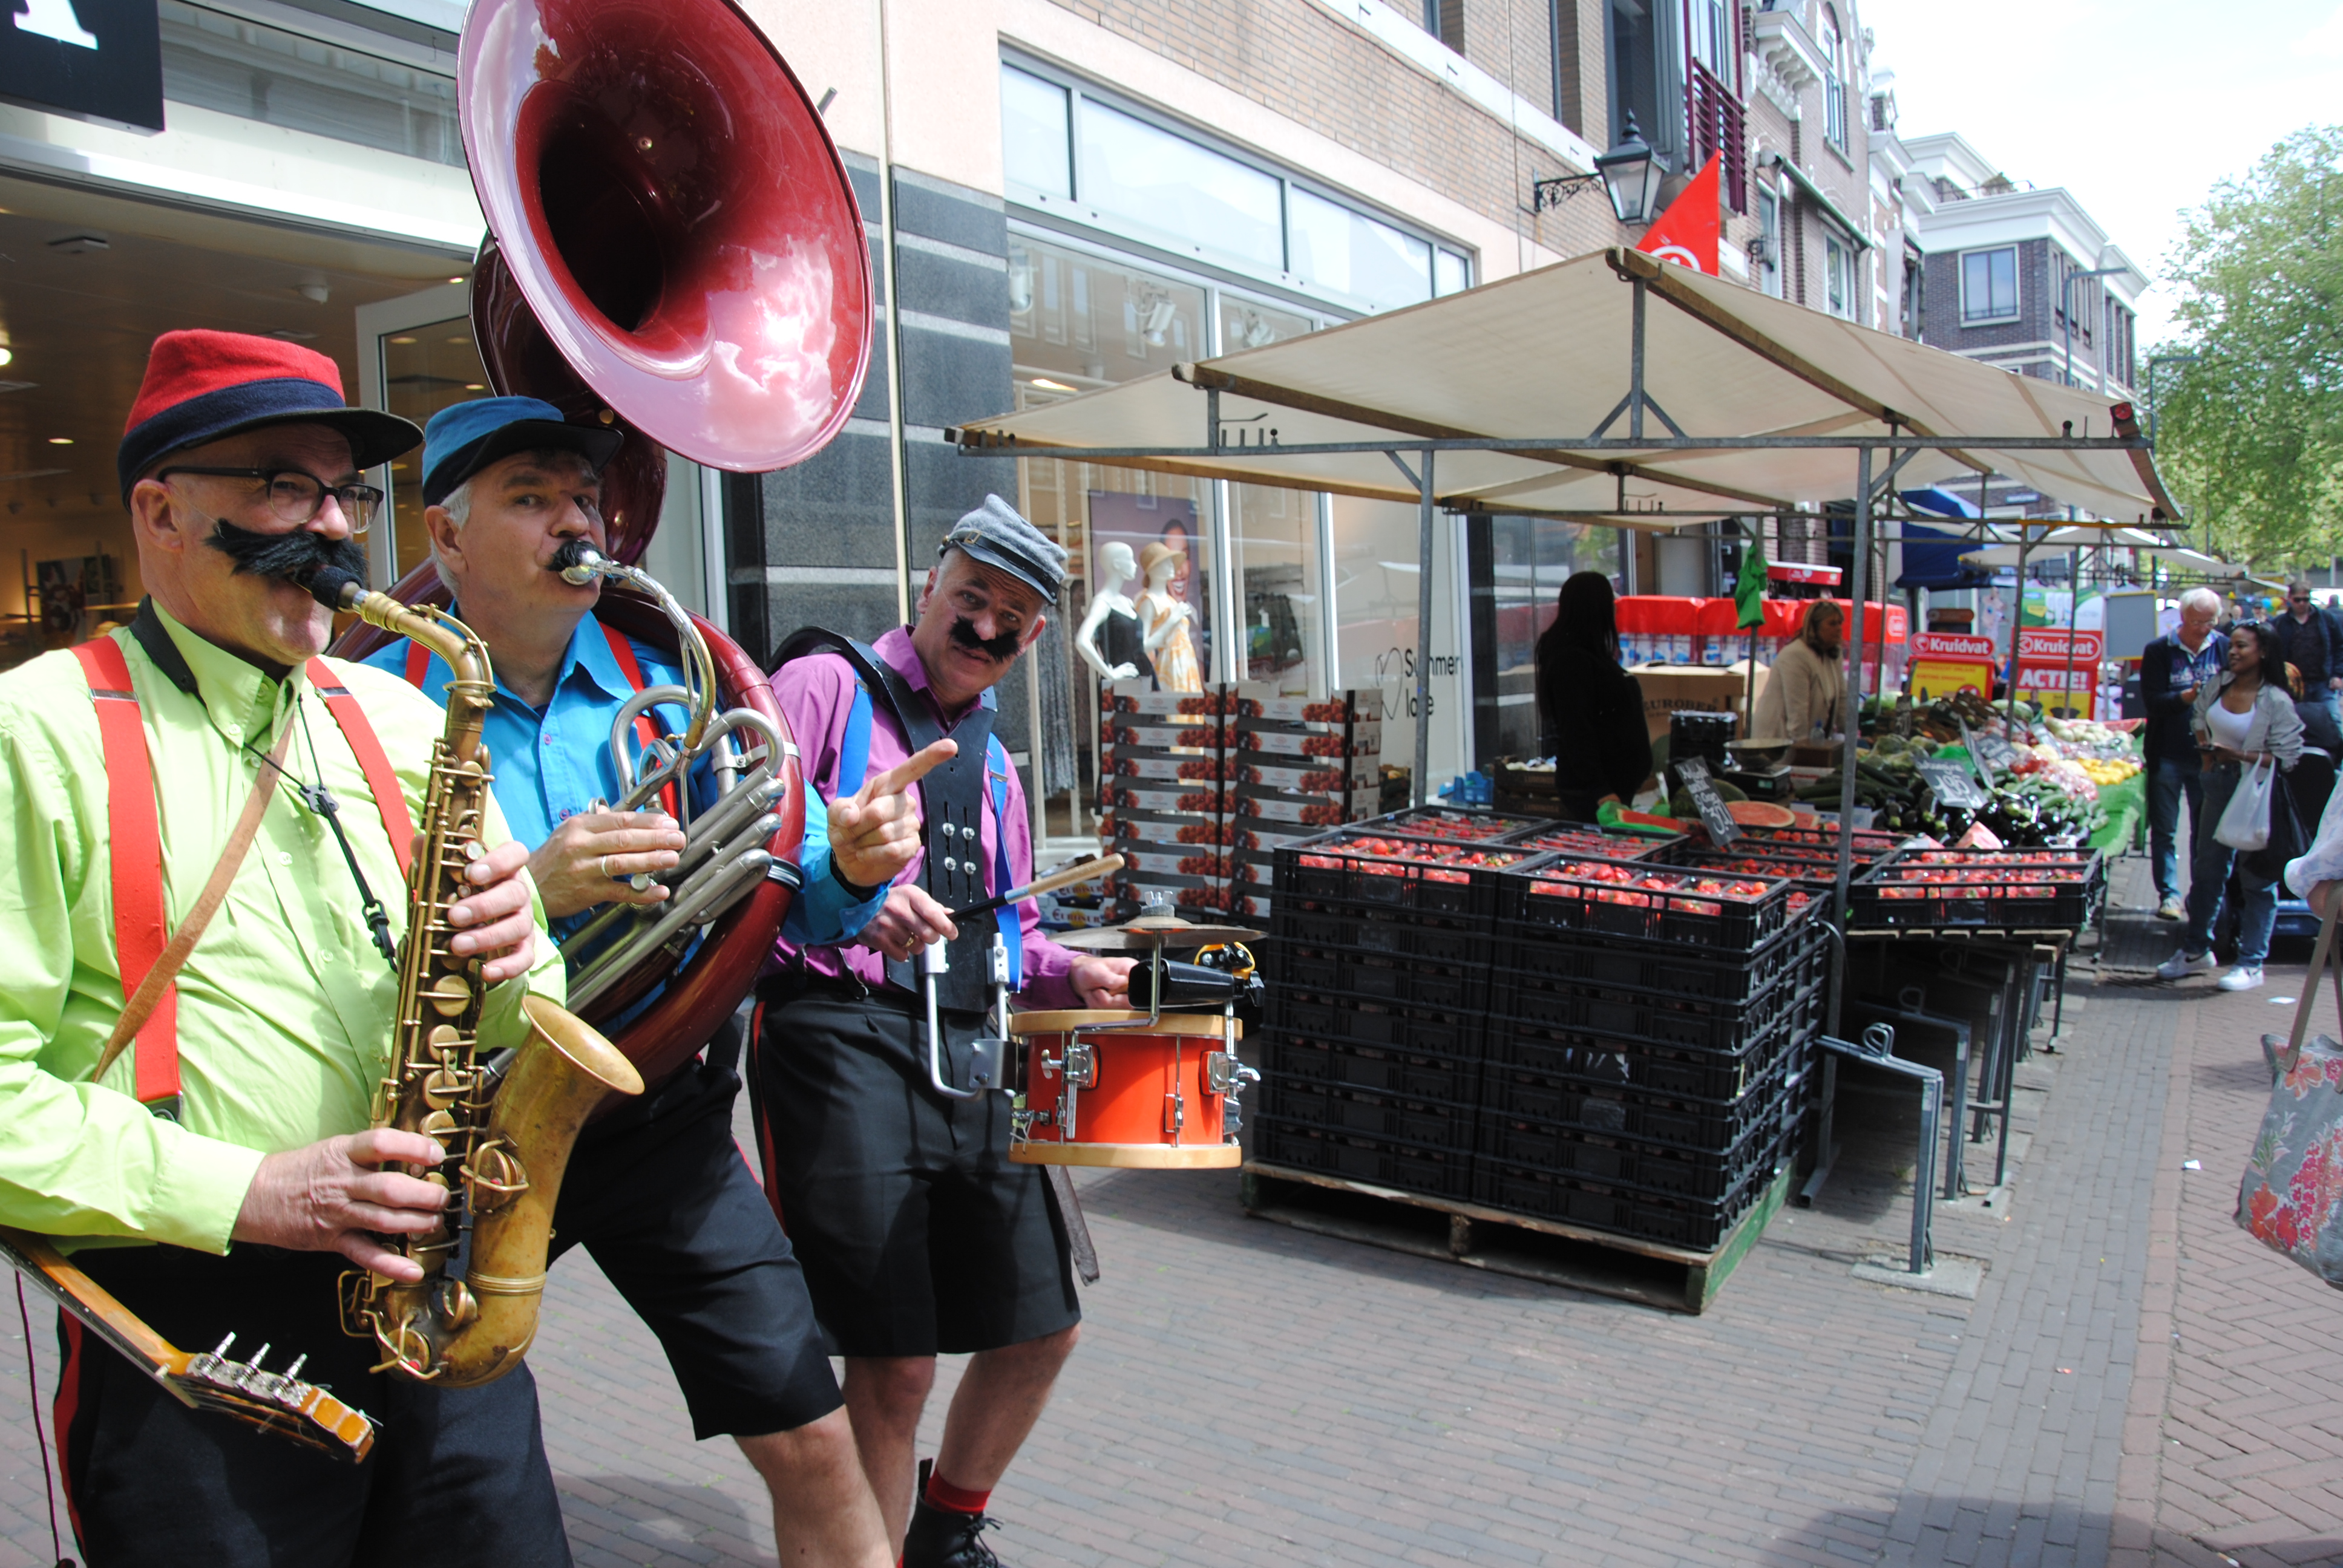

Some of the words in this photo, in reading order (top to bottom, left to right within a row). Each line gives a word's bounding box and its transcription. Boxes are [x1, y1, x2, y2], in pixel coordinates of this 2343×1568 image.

[1930, 637, 1990, 655] Kruidvat
[2019, 668, 2088, 690] ACTIE!
[1406, 688, 1434, 717] loe
